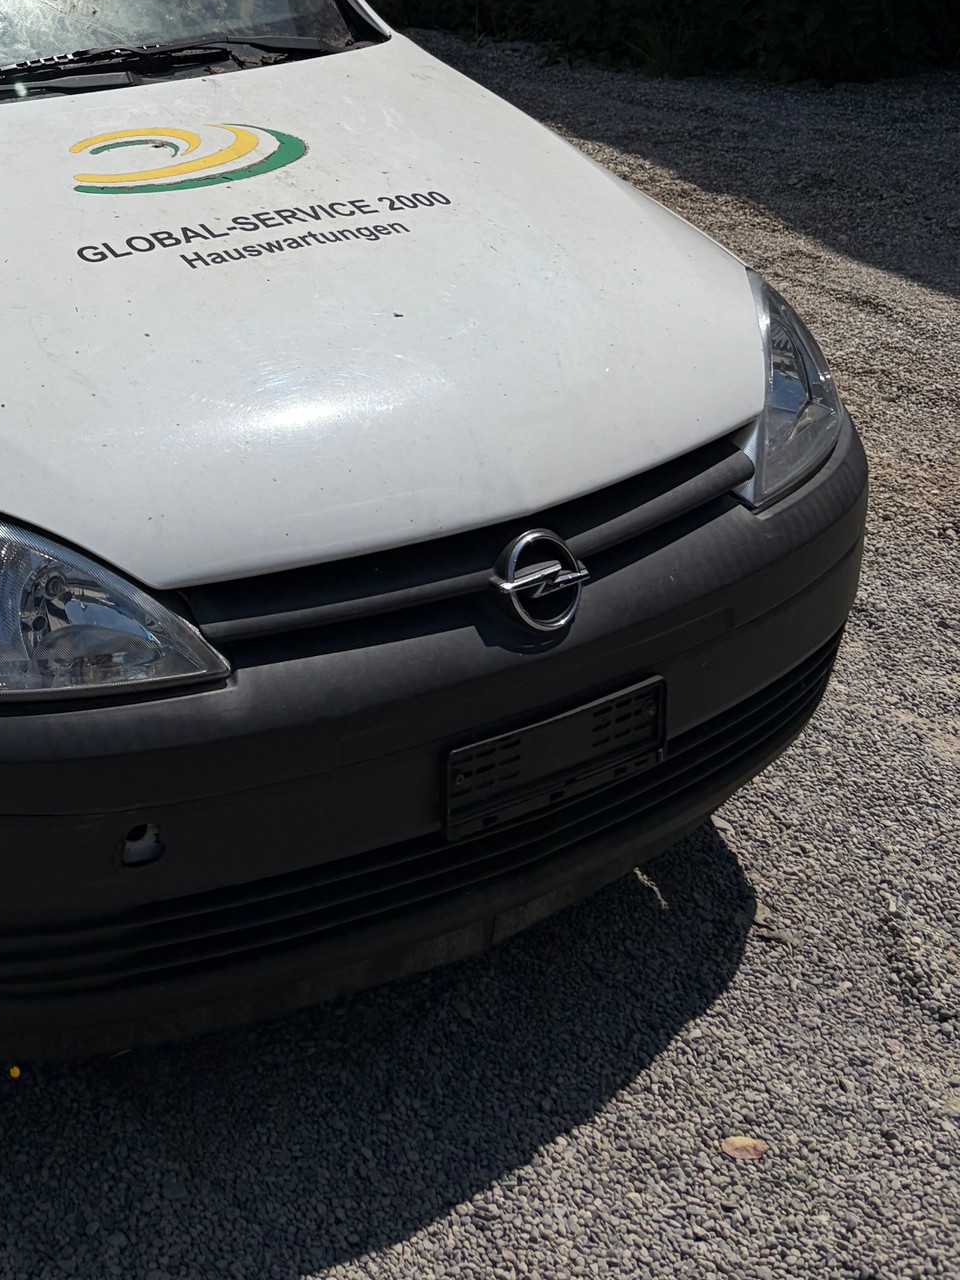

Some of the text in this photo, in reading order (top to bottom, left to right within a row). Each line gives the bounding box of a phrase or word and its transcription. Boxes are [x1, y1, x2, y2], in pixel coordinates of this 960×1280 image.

[76, 190, 452, 264] GLOBAL-SERVICE 2000
[179, 219, 411, 269] Hauswartungen
